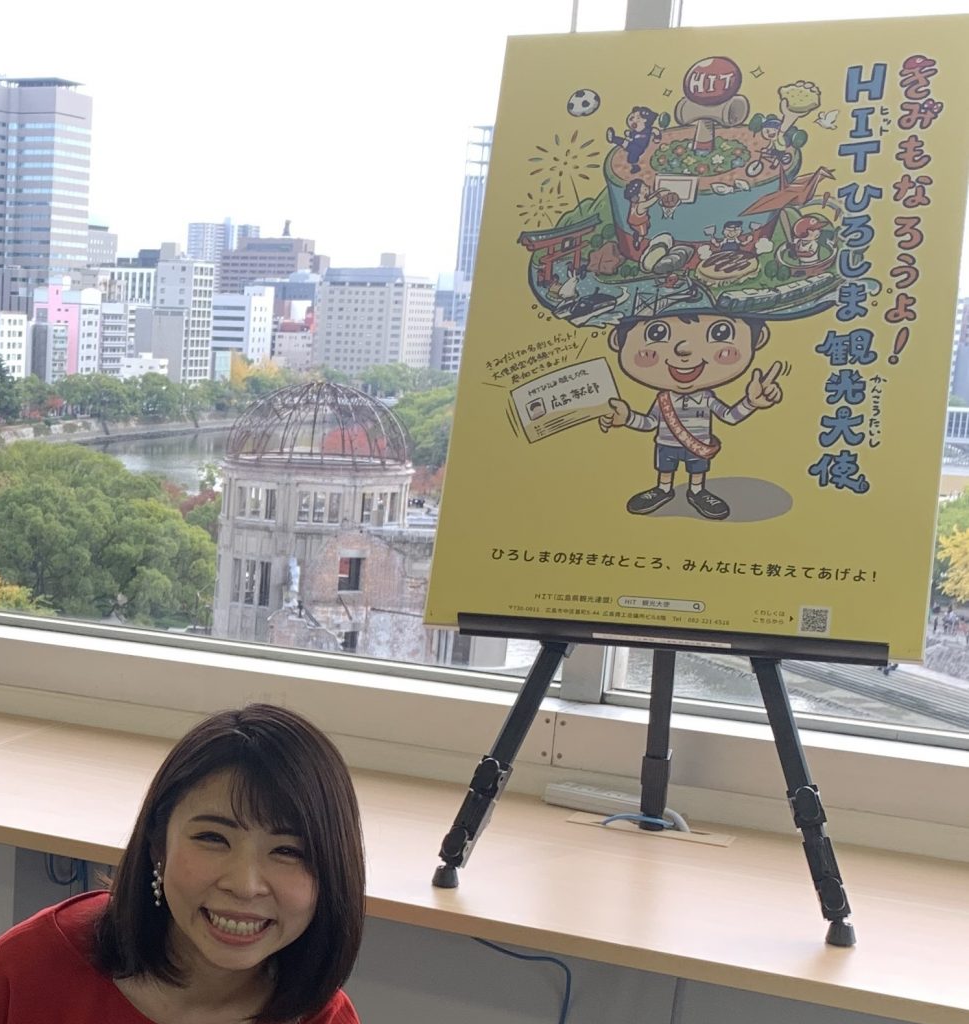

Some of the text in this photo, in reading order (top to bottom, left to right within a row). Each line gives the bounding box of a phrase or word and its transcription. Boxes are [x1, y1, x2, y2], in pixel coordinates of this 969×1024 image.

[689, 71, 734, 94] HIT
[642, 599, 671, 608] 観光大使
